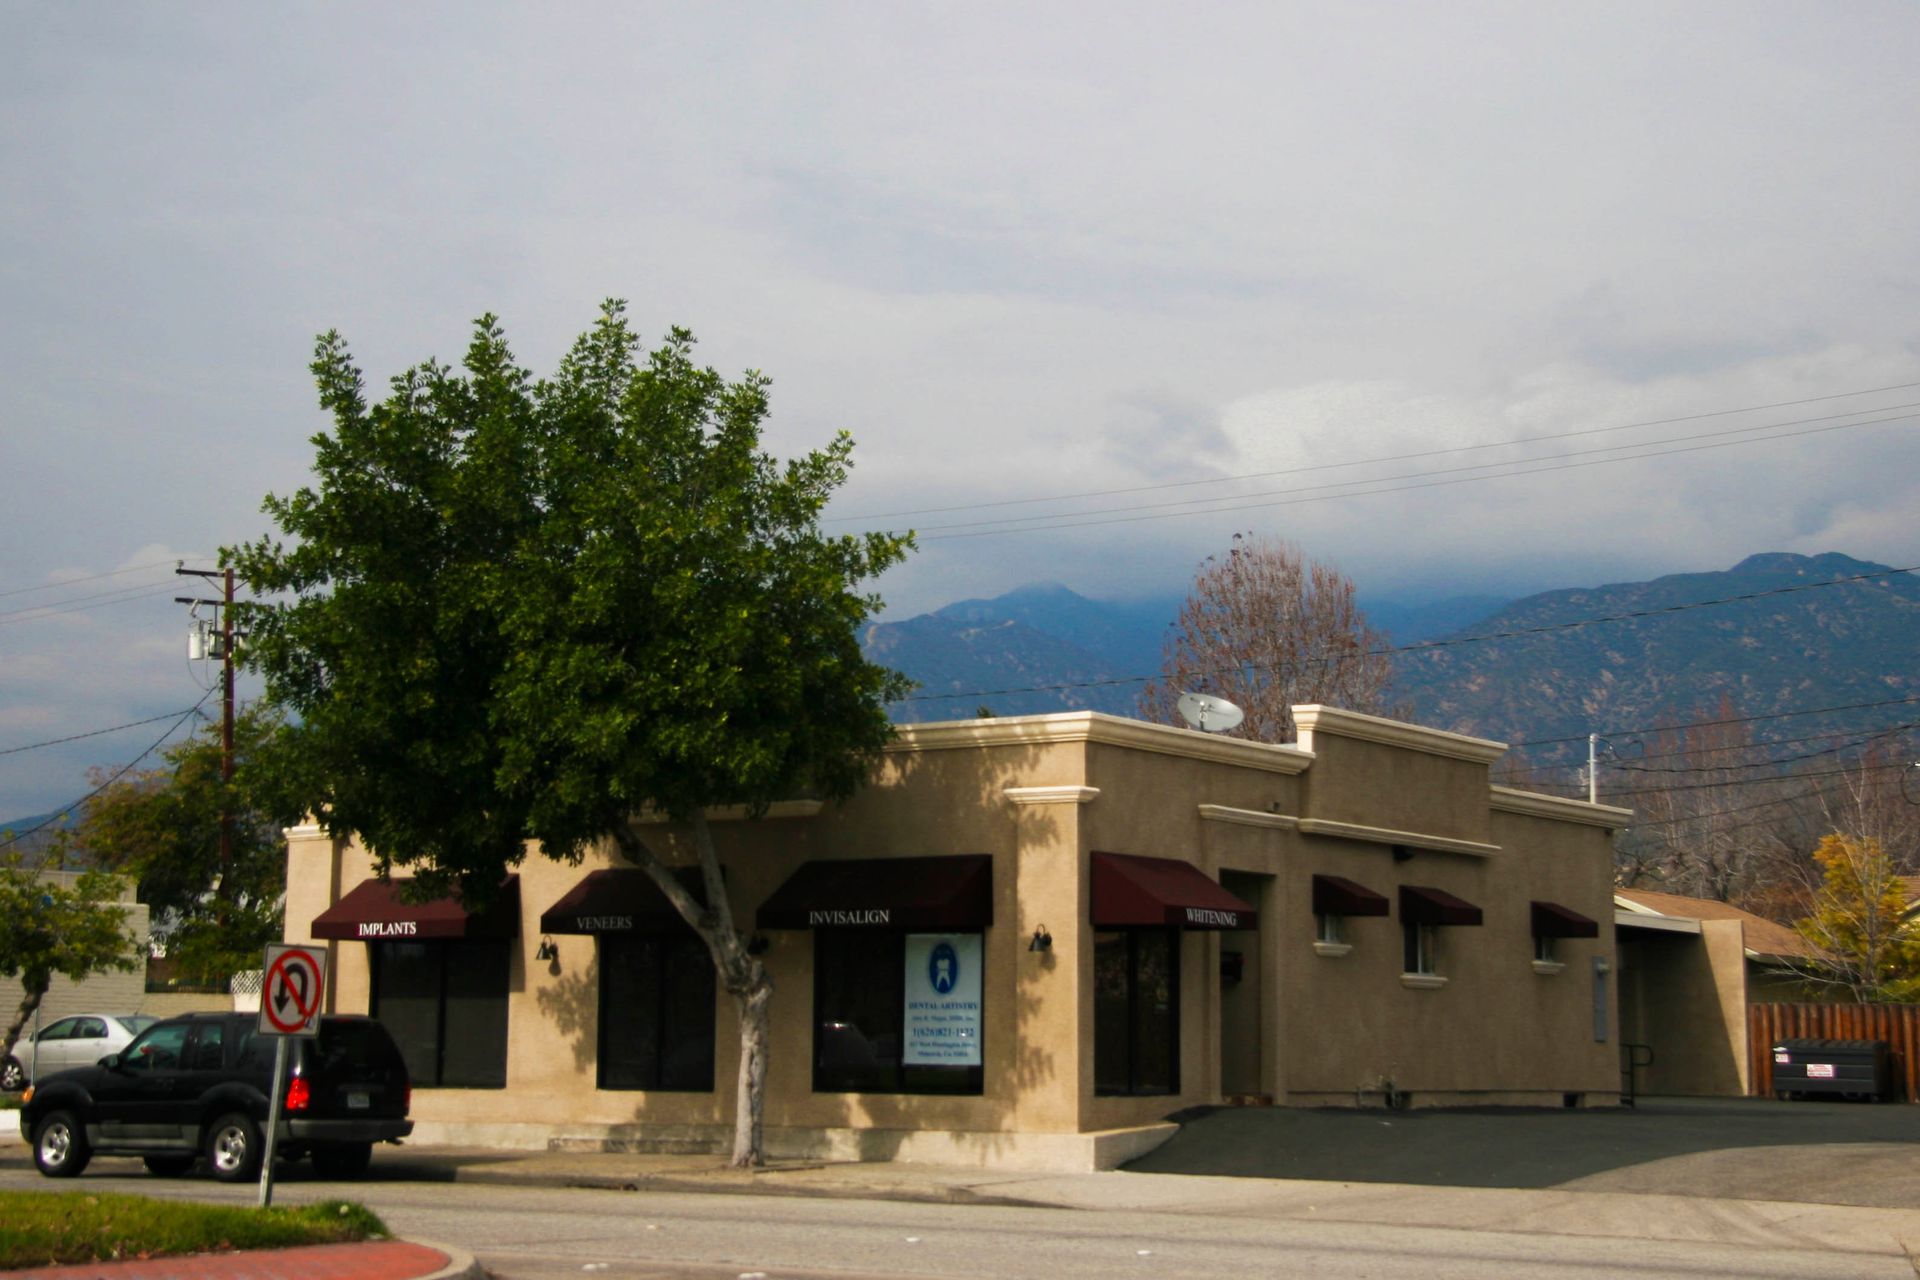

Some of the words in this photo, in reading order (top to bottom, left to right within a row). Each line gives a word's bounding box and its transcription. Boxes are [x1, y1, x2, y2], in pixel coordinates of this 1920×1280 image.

[576, 915, 633, 930] VENEERS
[809, 909, 890, 925] INVISALIGN
[1186, 908, 1237, 926] WHITENING
[358, 921, 417, 937] IMPLANTS
[908, 1002, 937, 1010] DENTAL
[940, 1002, 977, 1010] ARTISTRY
